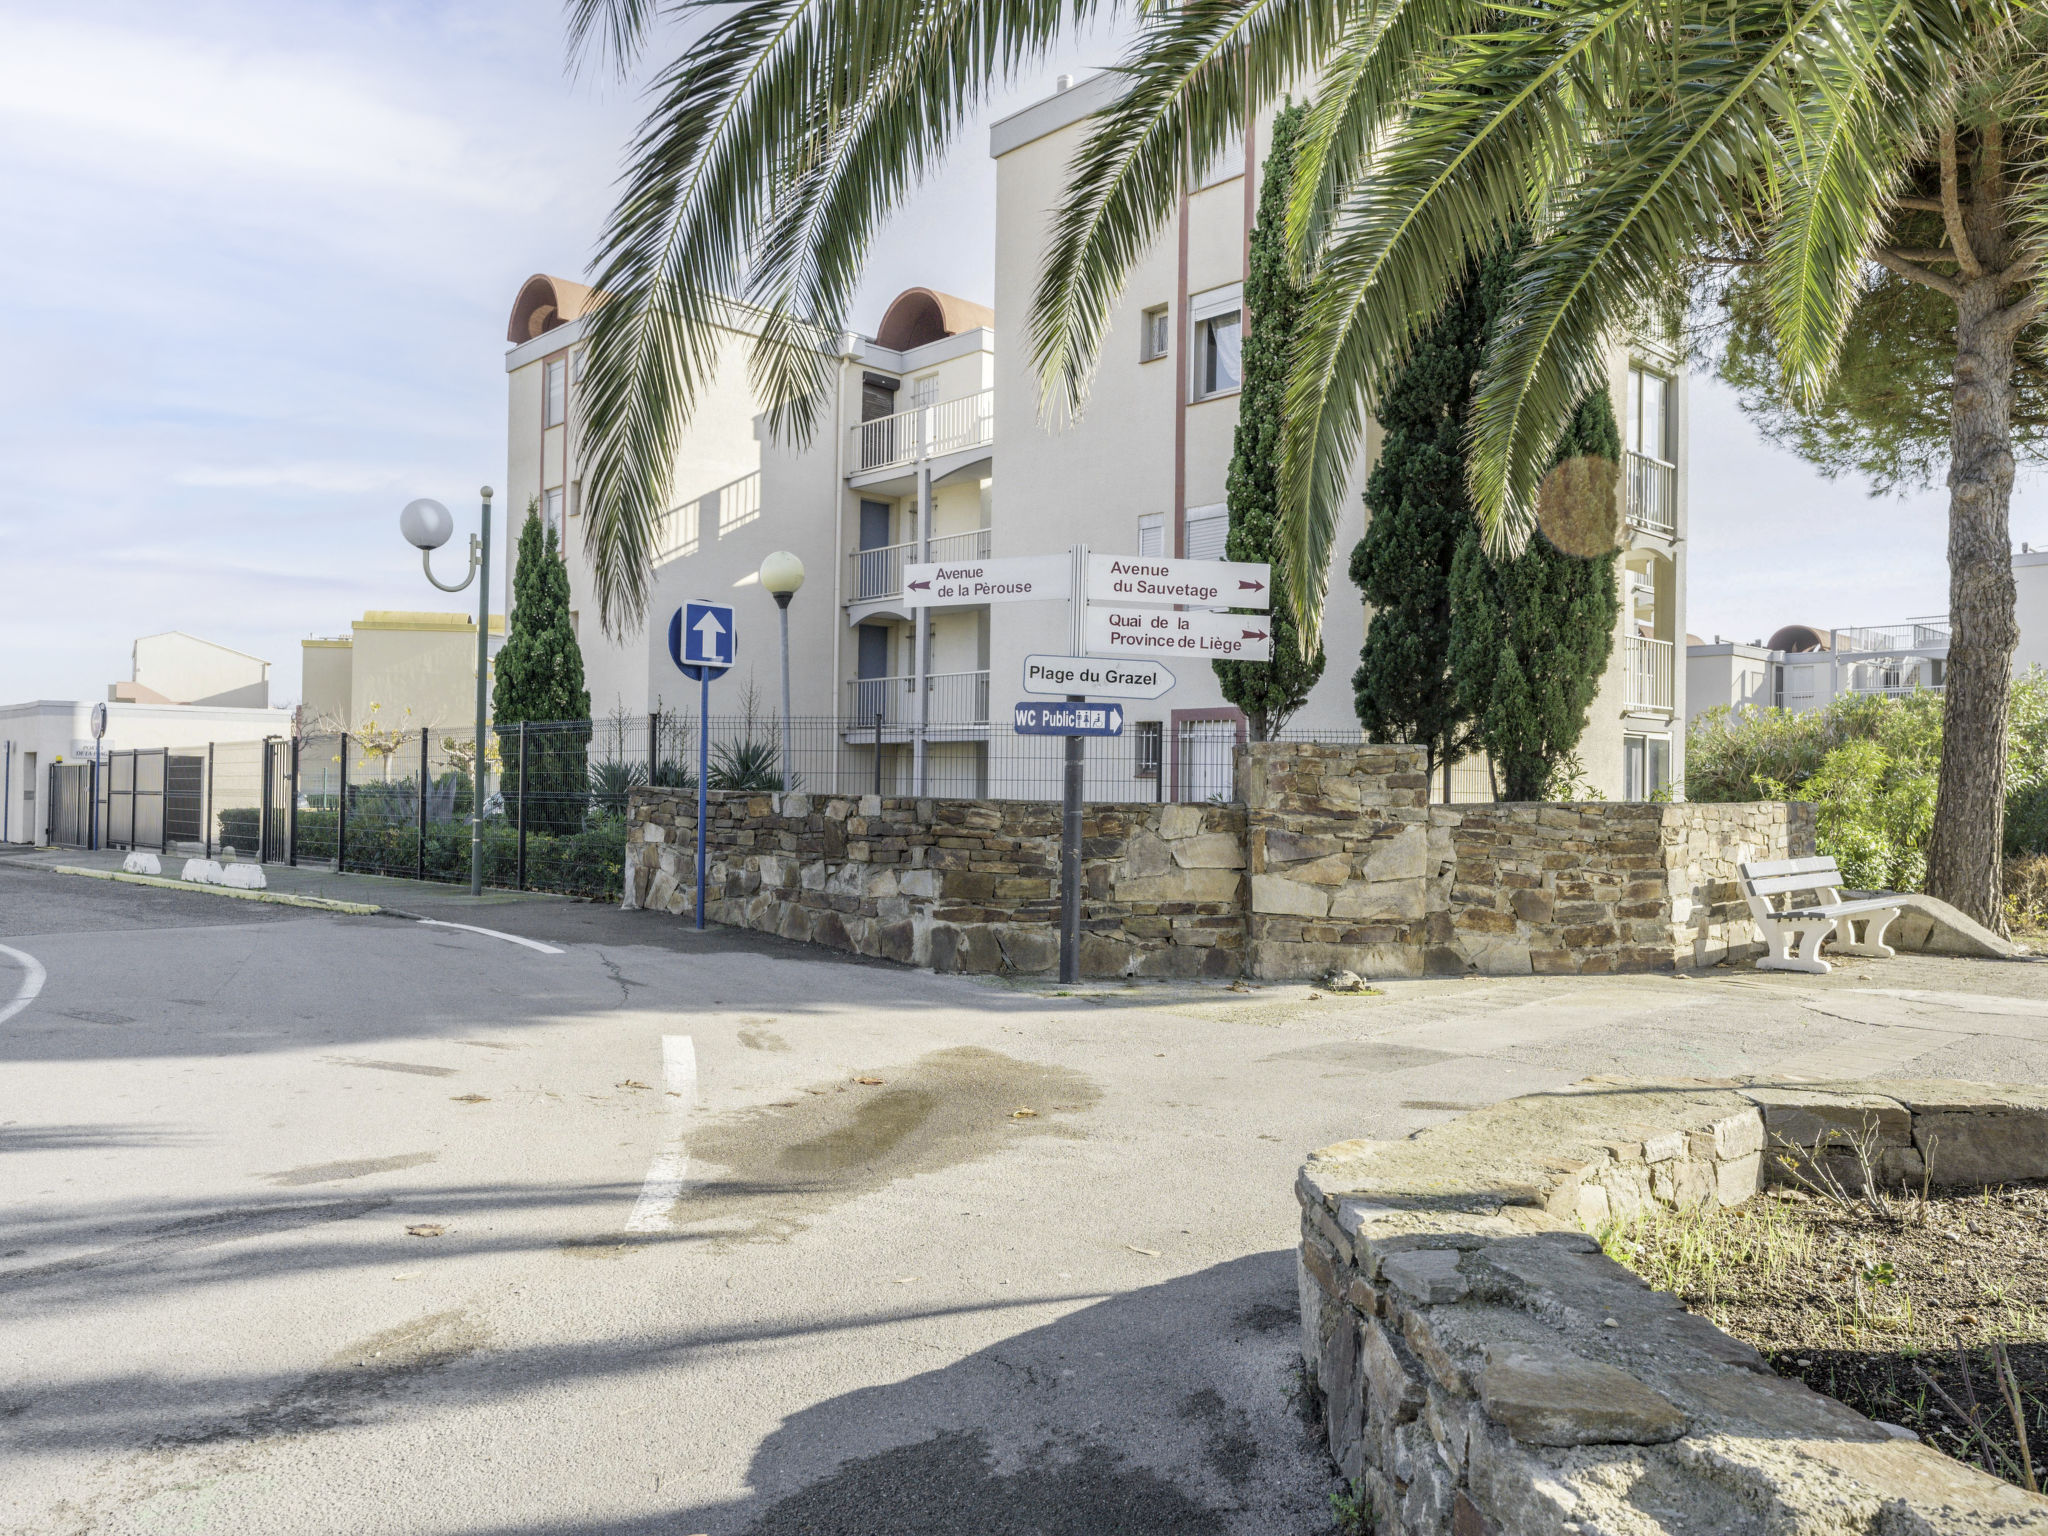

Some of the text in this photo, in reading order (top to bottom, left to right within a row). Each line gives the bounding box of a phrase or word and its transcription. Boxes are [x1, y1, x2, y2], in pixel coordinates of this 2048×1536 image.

[935, 567, 984, 581] Avenue
[1110, 561, 1169, 577] Avenue
[937, 583, 954, 598] de
[958, 583, 970, 597] la
[1113, 579, 1218, 601] du Sauvetage
[1109, 614, 1190, 630] Quai de la
[1110, 631, 1242, 654] Province de Liège
[1029, 665, 1157, 686] Plage du Grazel
[1015, 709, 1075, 728] WC Public
